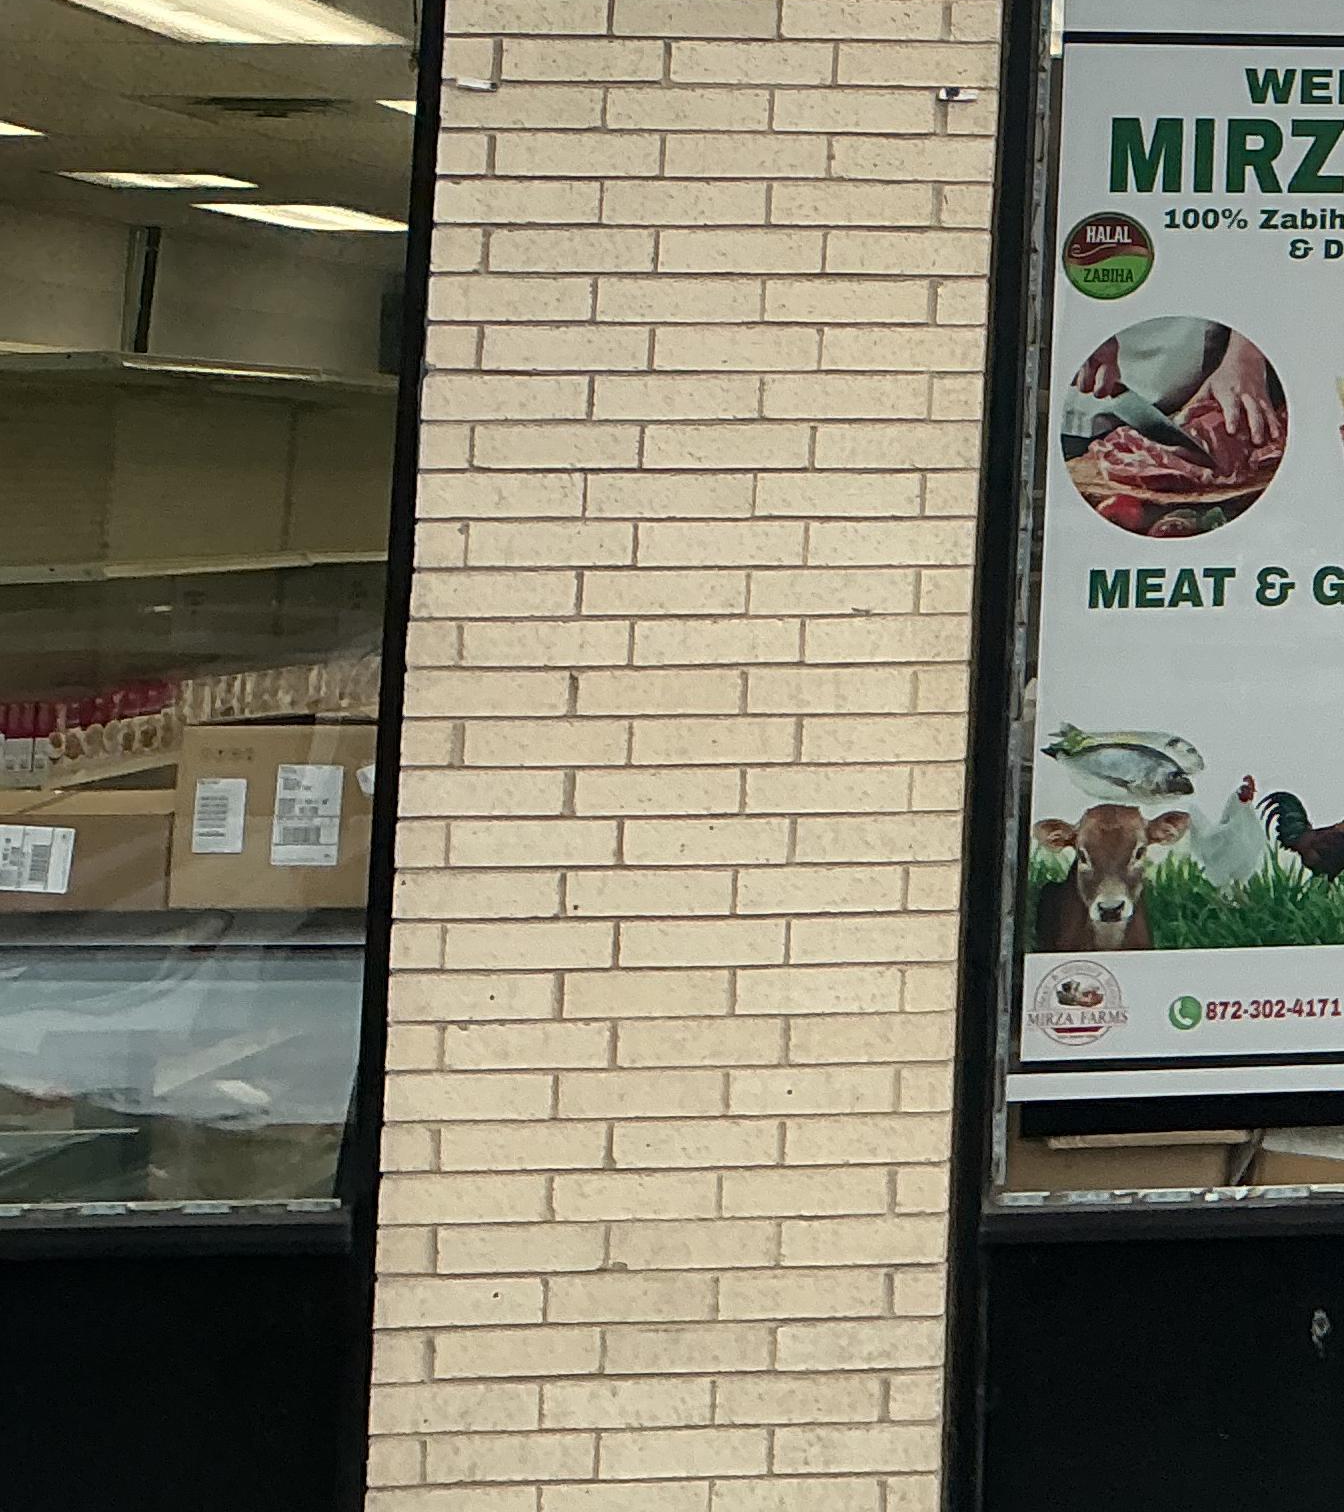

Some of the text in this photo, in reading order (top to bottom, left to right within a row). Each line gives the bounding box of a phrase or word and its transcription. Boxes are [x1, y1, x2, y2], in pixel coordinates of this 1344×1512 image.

[1163, 207, 1249, 230] 100%
[1085, 225, 1132, 244] HALAL
[1288, 238, 1314, 260] &
[1083, 267, 1134, 284] ZABIHA
[1087, 567, 1237, 609] MEAT
[1255, 566, 1296, 607] &
[1205, 998, 1342, 1022] 872-302-4171
